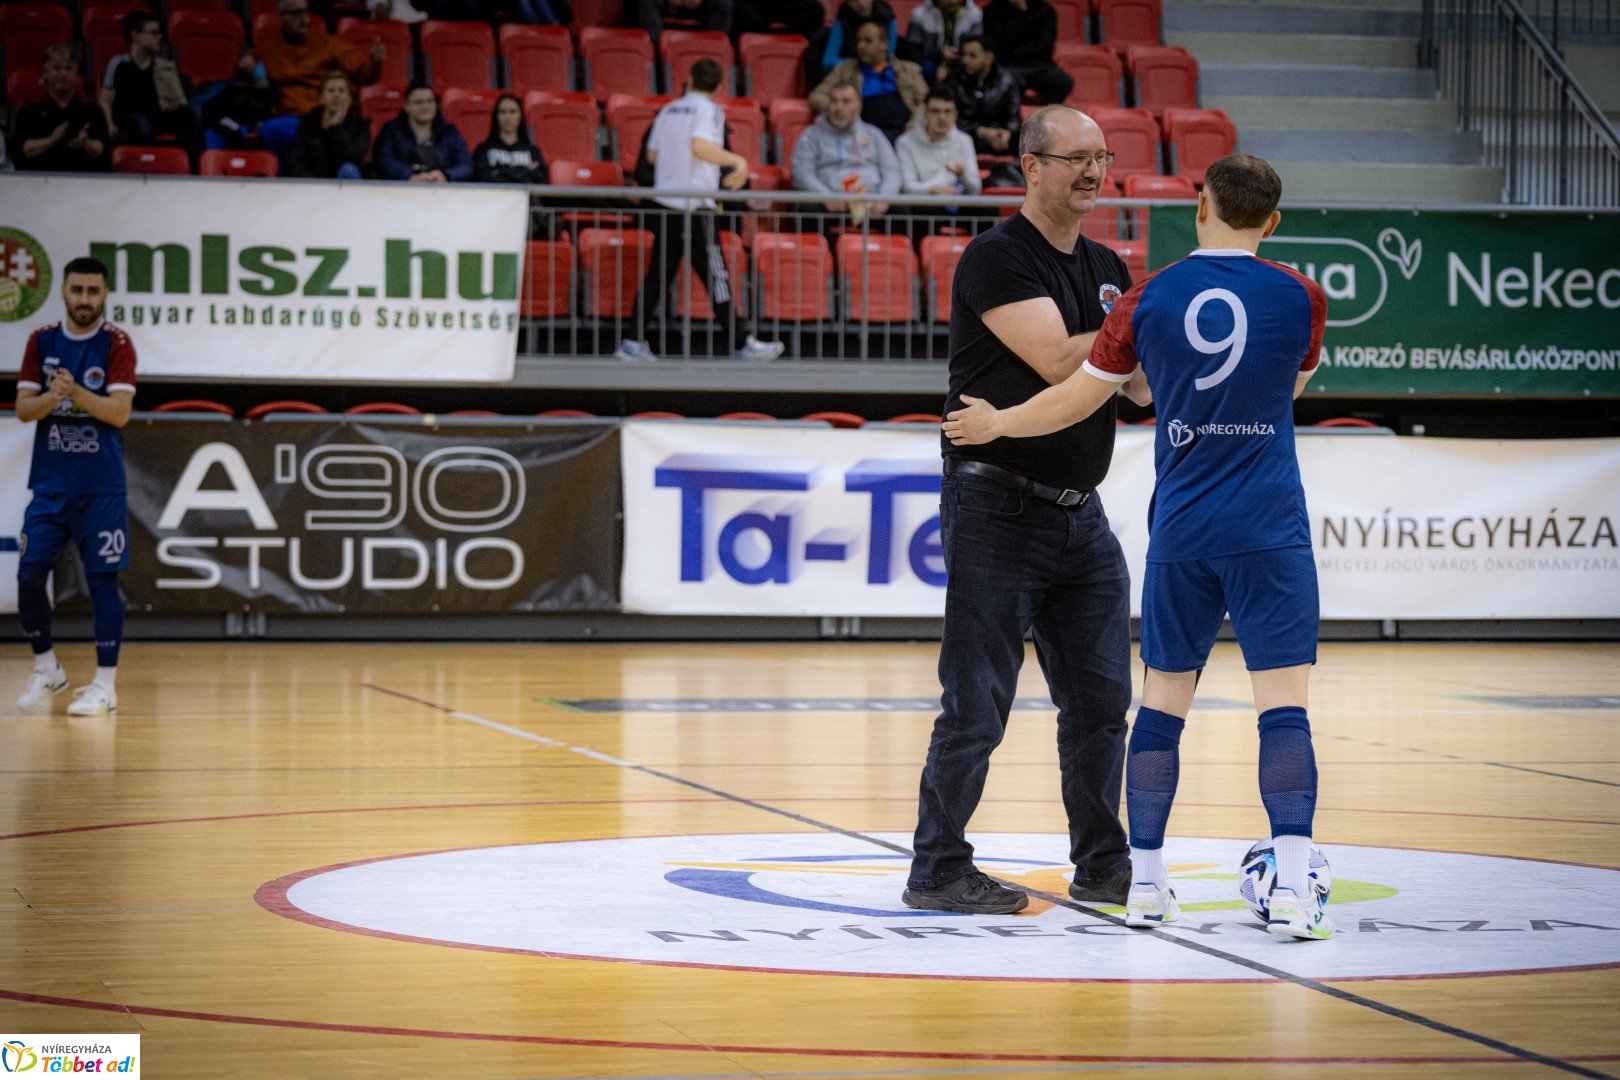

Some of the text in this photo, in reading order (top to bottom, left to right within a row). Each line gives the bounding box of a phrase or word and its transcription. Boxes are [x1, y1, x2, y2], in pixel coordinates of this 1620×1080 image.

[90, 234, 519, 301] mlsz.hu
[102, 304, 194, 326] agyar
[210, 304, 361, 329] Labdarúgó
[1184, 288, 1249, 391] 9
[1335, 343, 1406, 368] KORZÓ
[97, 528, 126, 557] 20
[1321, 508, 1619, 549] NYÍREGYHÁZA
[156, 537, 525, 590] STUDIO
[1320, 555, 1619, 573] MEGYEI JOGÚ VÁROS ÖNKORMÁNYZATA
[645, 918, 1620, 943] NYÍREGYÁZA
